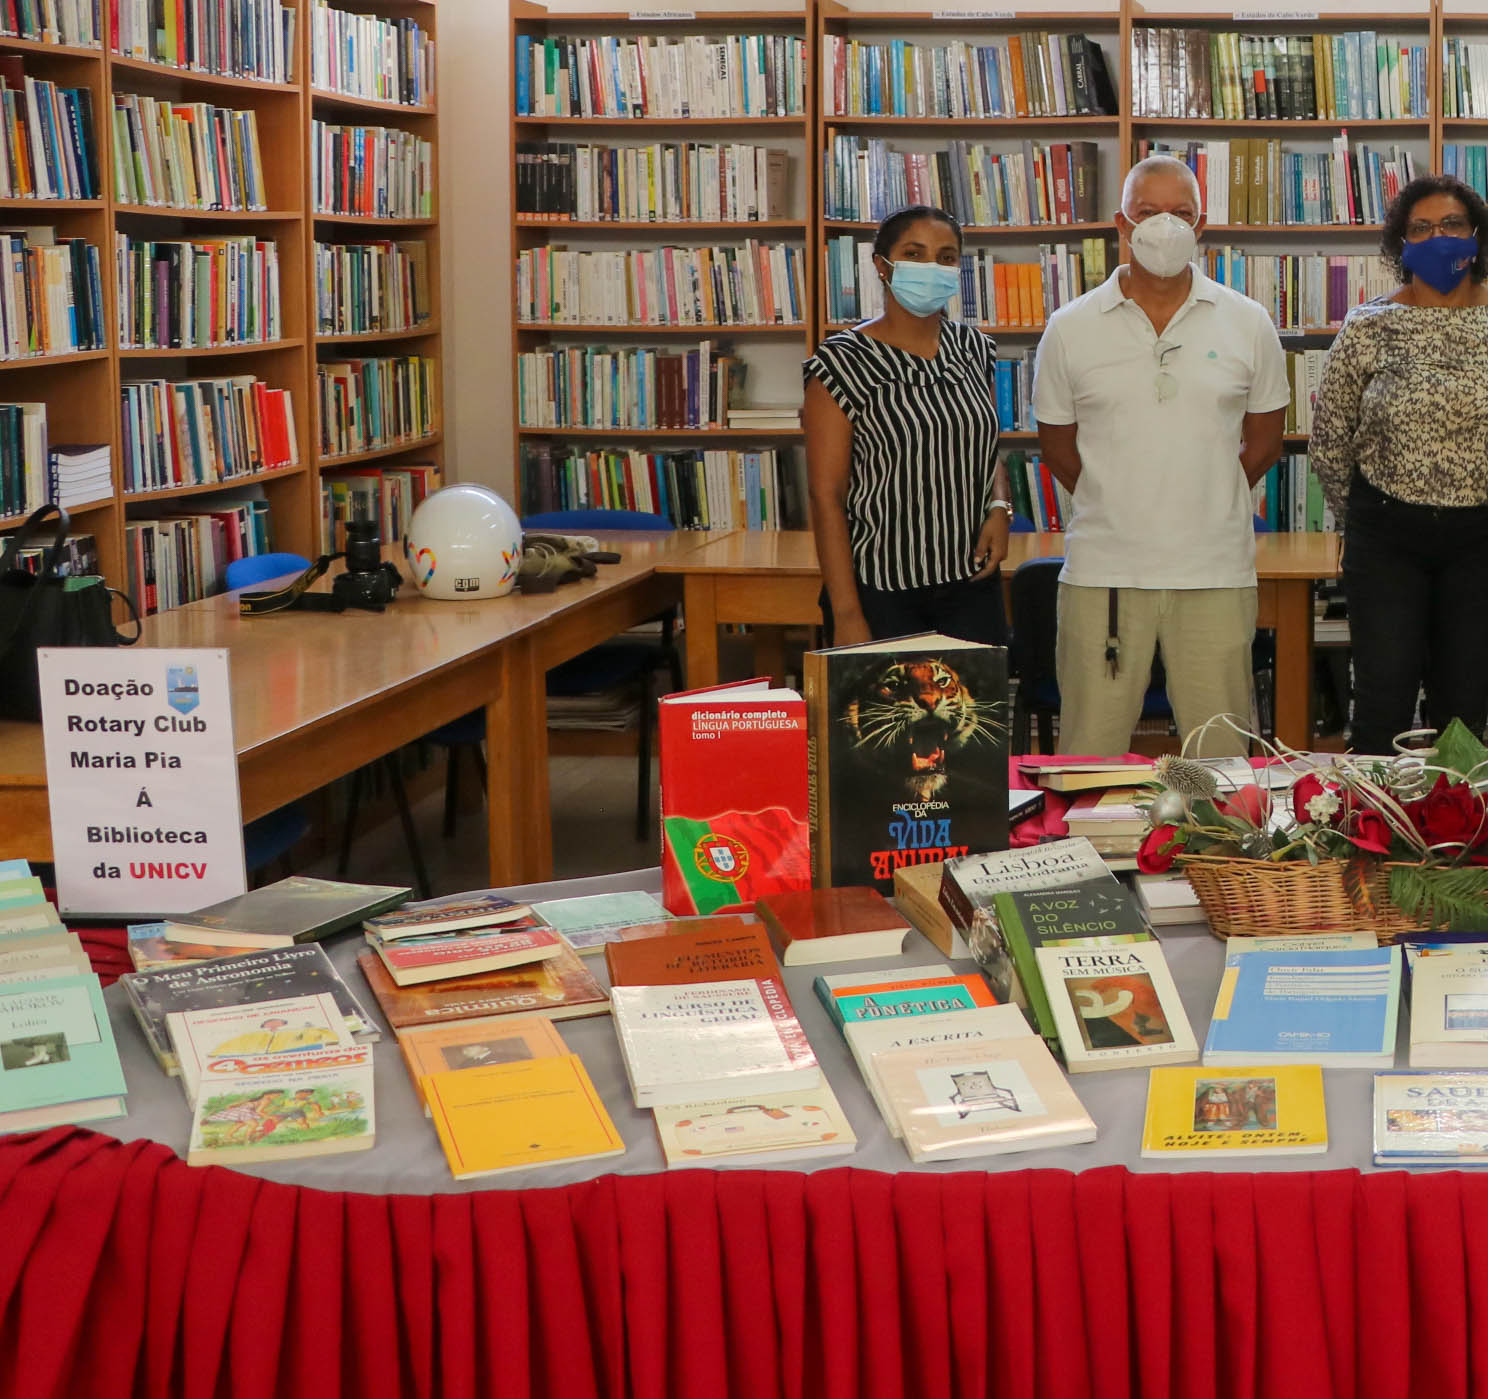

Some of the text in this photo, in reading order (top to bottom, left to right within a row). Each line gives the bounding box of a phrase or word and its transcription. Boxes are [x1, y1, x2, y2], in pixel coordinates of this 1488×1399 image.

[719, 46, 727, 81] SENEGAL
[64, 678, 154, 700] Doação
[691, 710, 788, 721] dicionário completo
[68, 716, 207, 737] Rotary Club
[692, 718, 799, 731] LÍNGUA PORTUGUESA
[70, 752, 182, 769] Maria Pia
[136, 786, 153, 808] Á
[892, 801, 950, 813] ENCICLOPÉDIA
[915, 810, 927, 818] DA
[87, 827, 208, 844] Biblioteca
[889, 811, 952, 850] VIDA
[93, 863, 207, 880] da UNICV
[972, 862, 1089, 886] Um melodrama
[1029, 900, 1080, 912] A VOZ
[1033, 914, 1058, 923] DO
[1037, 919, 1117, 935] SILÊNCIO
[132, 949, 317, 985] O Meu Primeiro Livro
[1058, 953, 1144, 968] TERRA
[169, 980, 191, 990] de
[195, 962, 293, 985] Astronomia
[1062, 963, 1147, 976] SEM MÚSICA
[666, 999, 757, 1011] CURSO DE
[762, 979, 799, 1041] ENCLOPEDIA
[864, 996, 877, 1009] A
[890, 1030, 984, 1047] A ESCRITA
[1163, 1140, 1211, 1148] HOJE
[1240, 1136, 1309, 1146] SEMPRE
